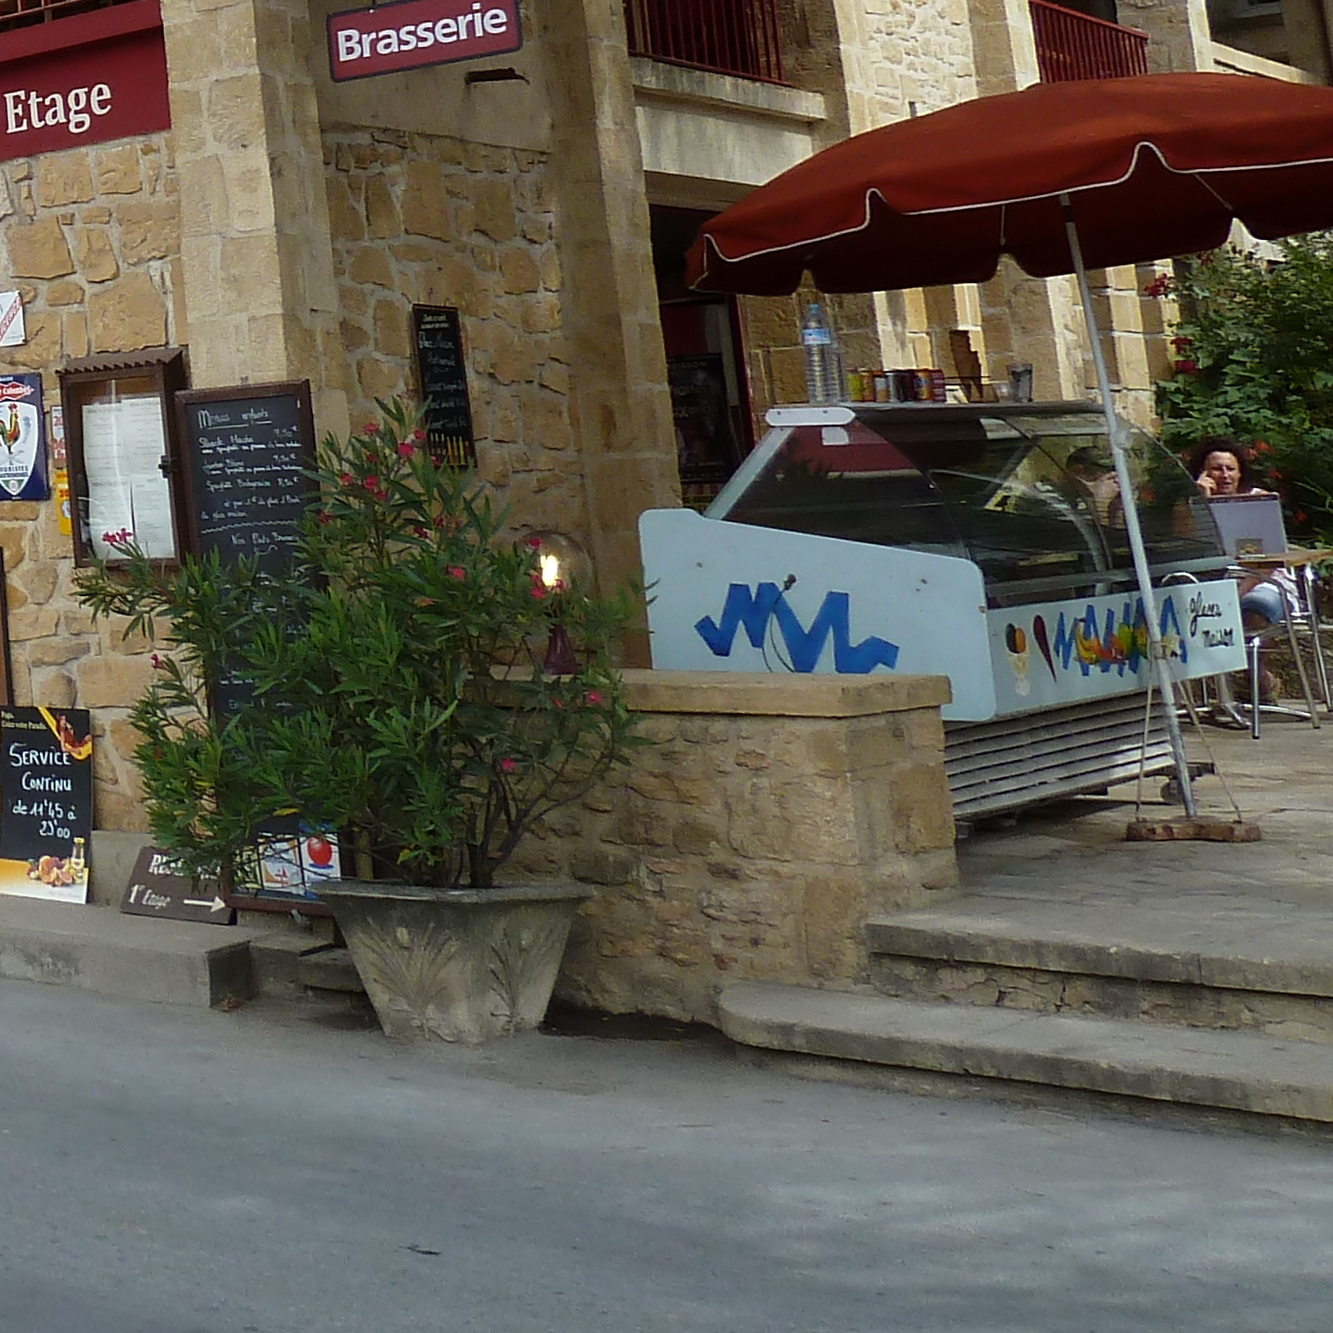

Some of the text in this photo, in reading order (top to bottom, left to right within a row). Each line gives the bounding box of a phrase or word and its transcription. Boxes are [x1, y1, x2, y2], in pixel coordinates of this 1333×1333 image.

[337, 2, 507, 62] Brasserie
[4, 81, 113, 134] Etage
[12, 799, 28, 815] de
[67, 805, 76, 820] à
